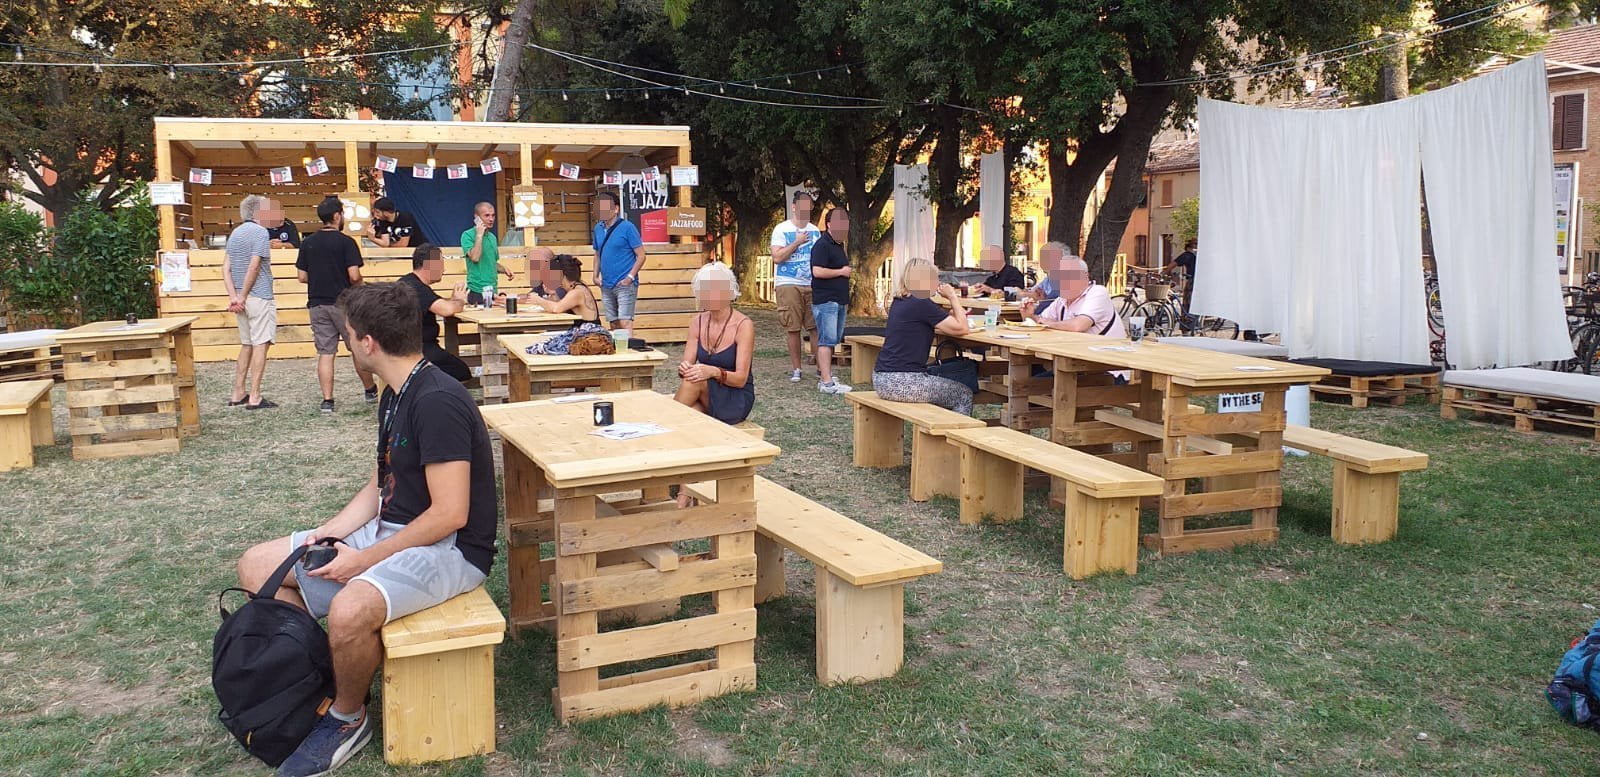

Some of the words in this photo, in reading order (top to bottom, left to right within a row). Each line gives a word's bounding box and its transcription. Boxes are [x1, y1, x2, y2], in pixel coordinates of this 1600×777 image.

[639, 194, 669, 209] JAZZ
[670, 220, 704, 228] JAZZ&FOOD
[1222, 397, 1231, 408] BY
[1232, 395, 1250, 407] THE
[1251, 393, 1262, 404] SE
